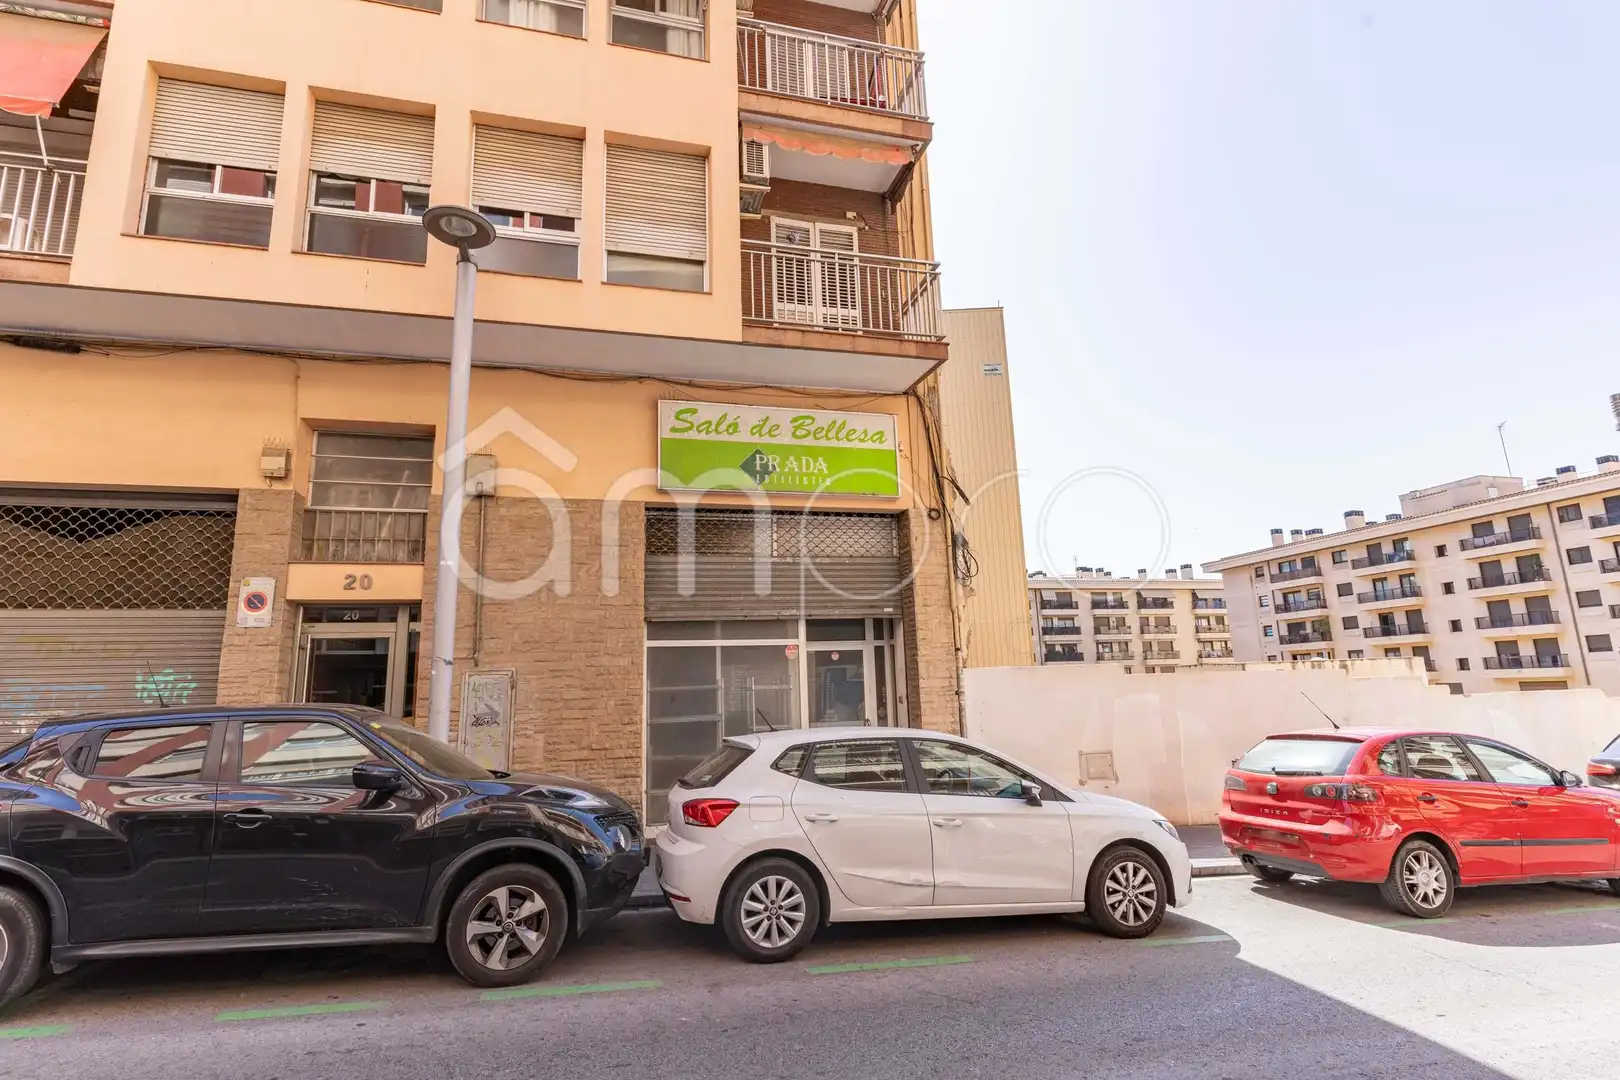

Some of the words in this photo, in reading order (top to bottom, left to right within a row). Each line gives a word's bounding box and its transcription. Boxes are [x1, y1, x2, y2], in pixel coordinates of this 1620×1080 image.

[669, 407, 741, 435] Saló
[750, 415, 783, 438] de
[790, 415, 888, 445] Bellesa
[755, 454, 829, 474] PRADA
[343, 573, 374, 591] 20
[343, 609, 360, 621] 20
